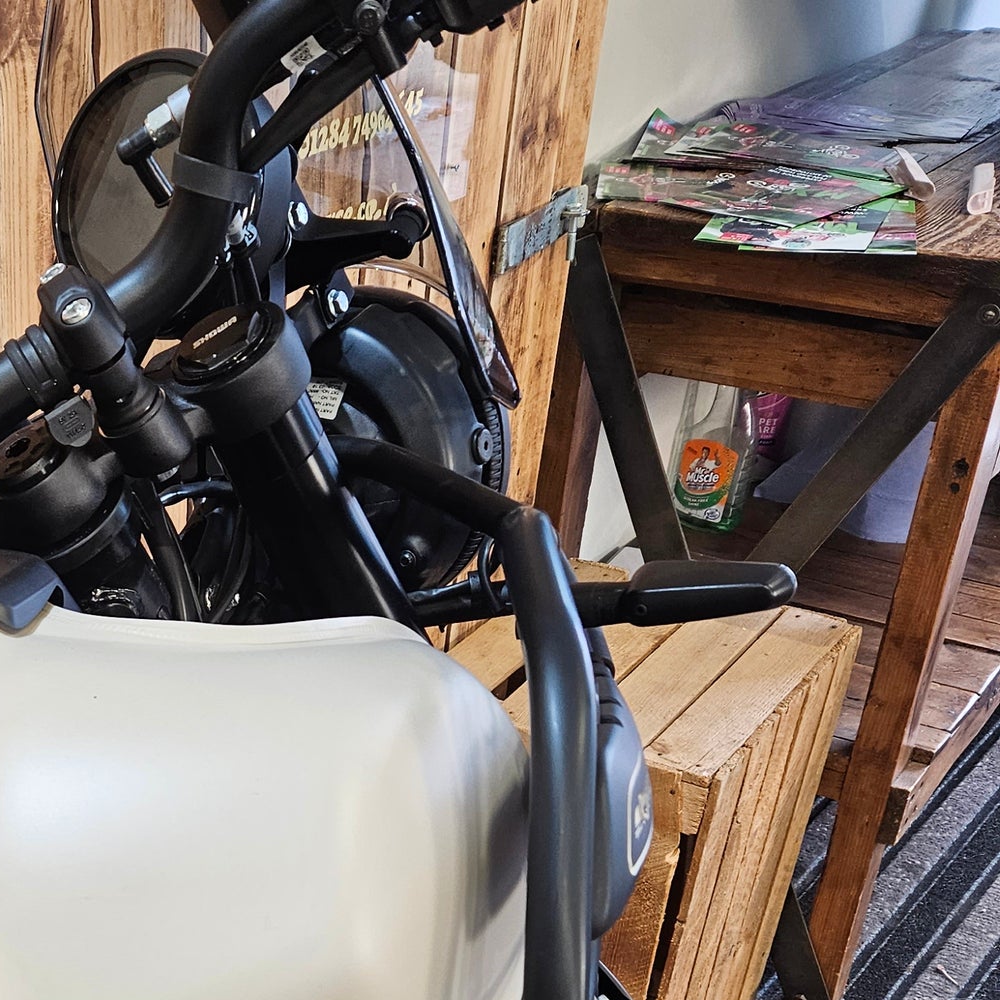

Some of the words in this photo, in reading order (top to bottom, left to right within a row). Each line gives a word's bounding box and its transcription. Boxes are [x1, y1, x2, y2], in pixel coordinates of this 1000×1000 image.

[192, 315, 238, 350] SHOWA
[758, 417, 778, 426] PET
[686, 471, 719, 483] Muscle
